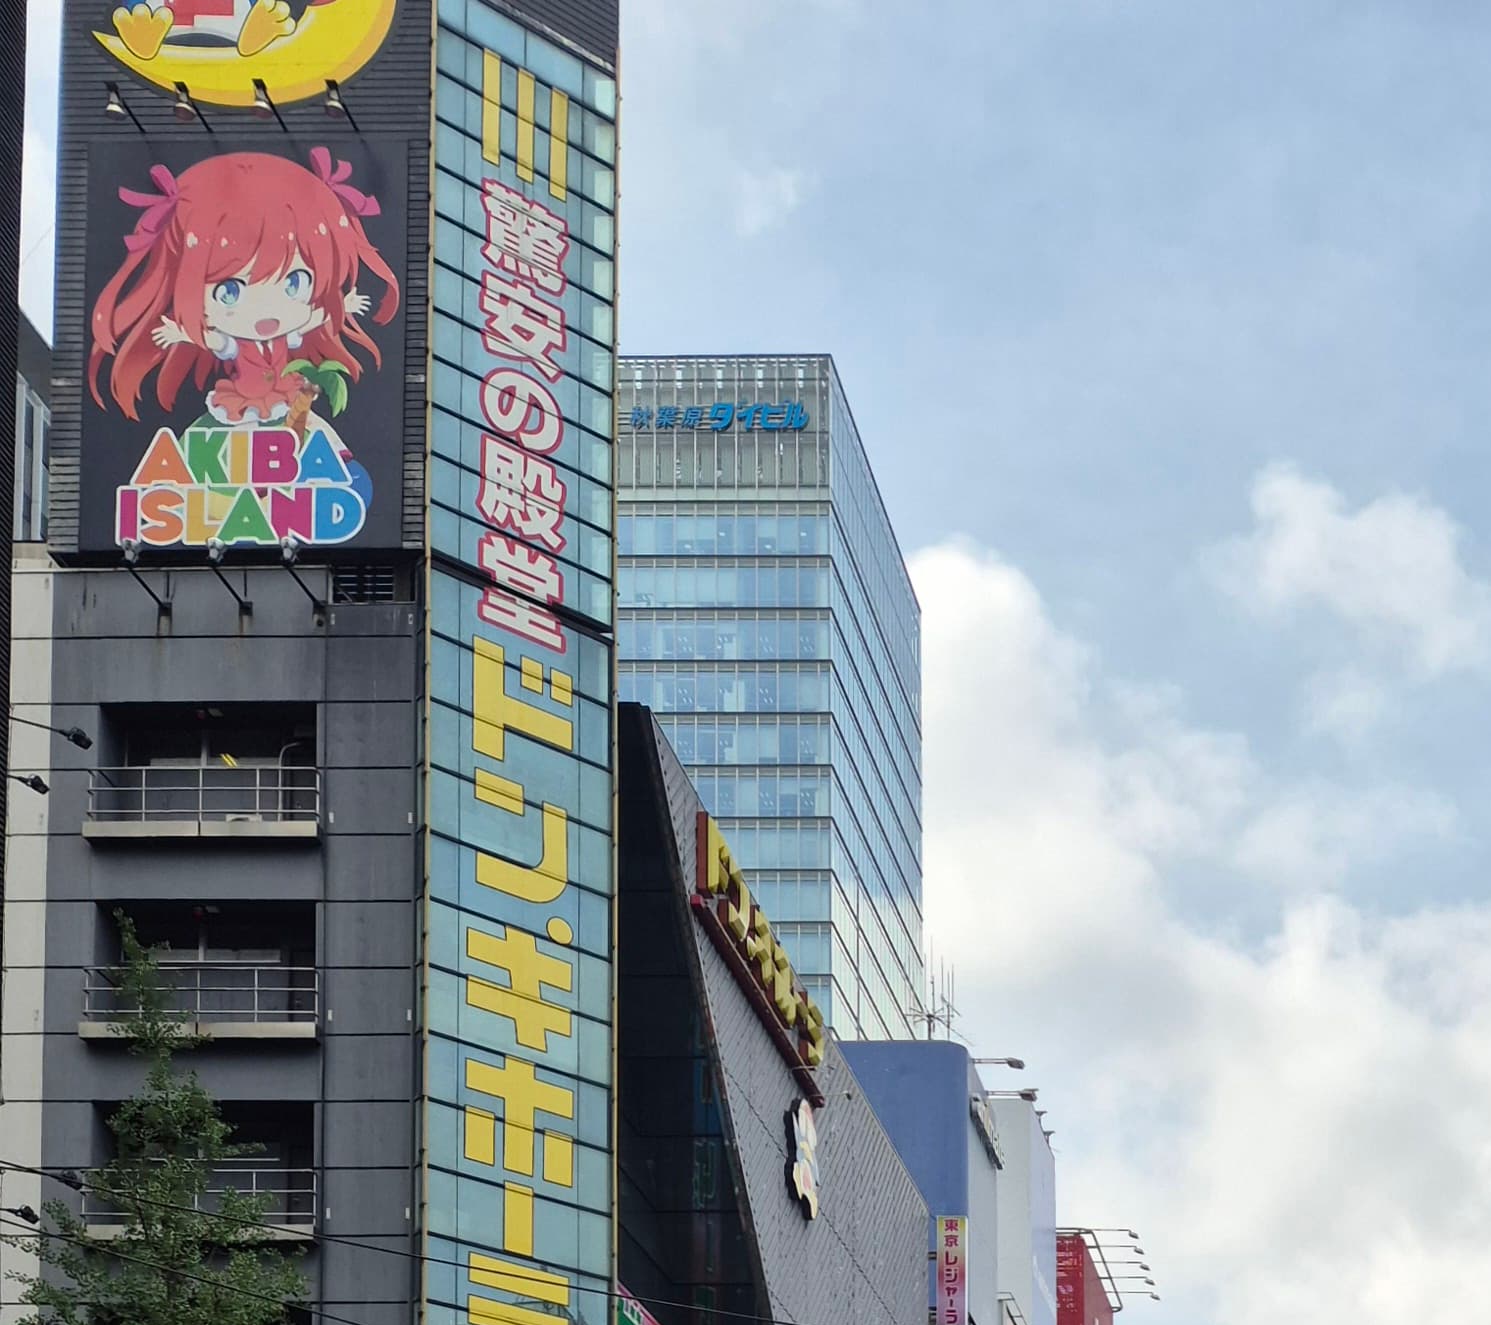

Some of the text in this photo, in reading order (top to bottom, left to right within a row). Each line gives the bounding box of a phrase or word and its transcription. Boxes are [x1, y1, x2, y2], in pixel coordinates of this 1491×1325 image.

[480, 177, 570, 655] 驚安の殿堂
[131, 427, 350, 486] AKIBA
[117, 486, 365, 546] ISLAND
